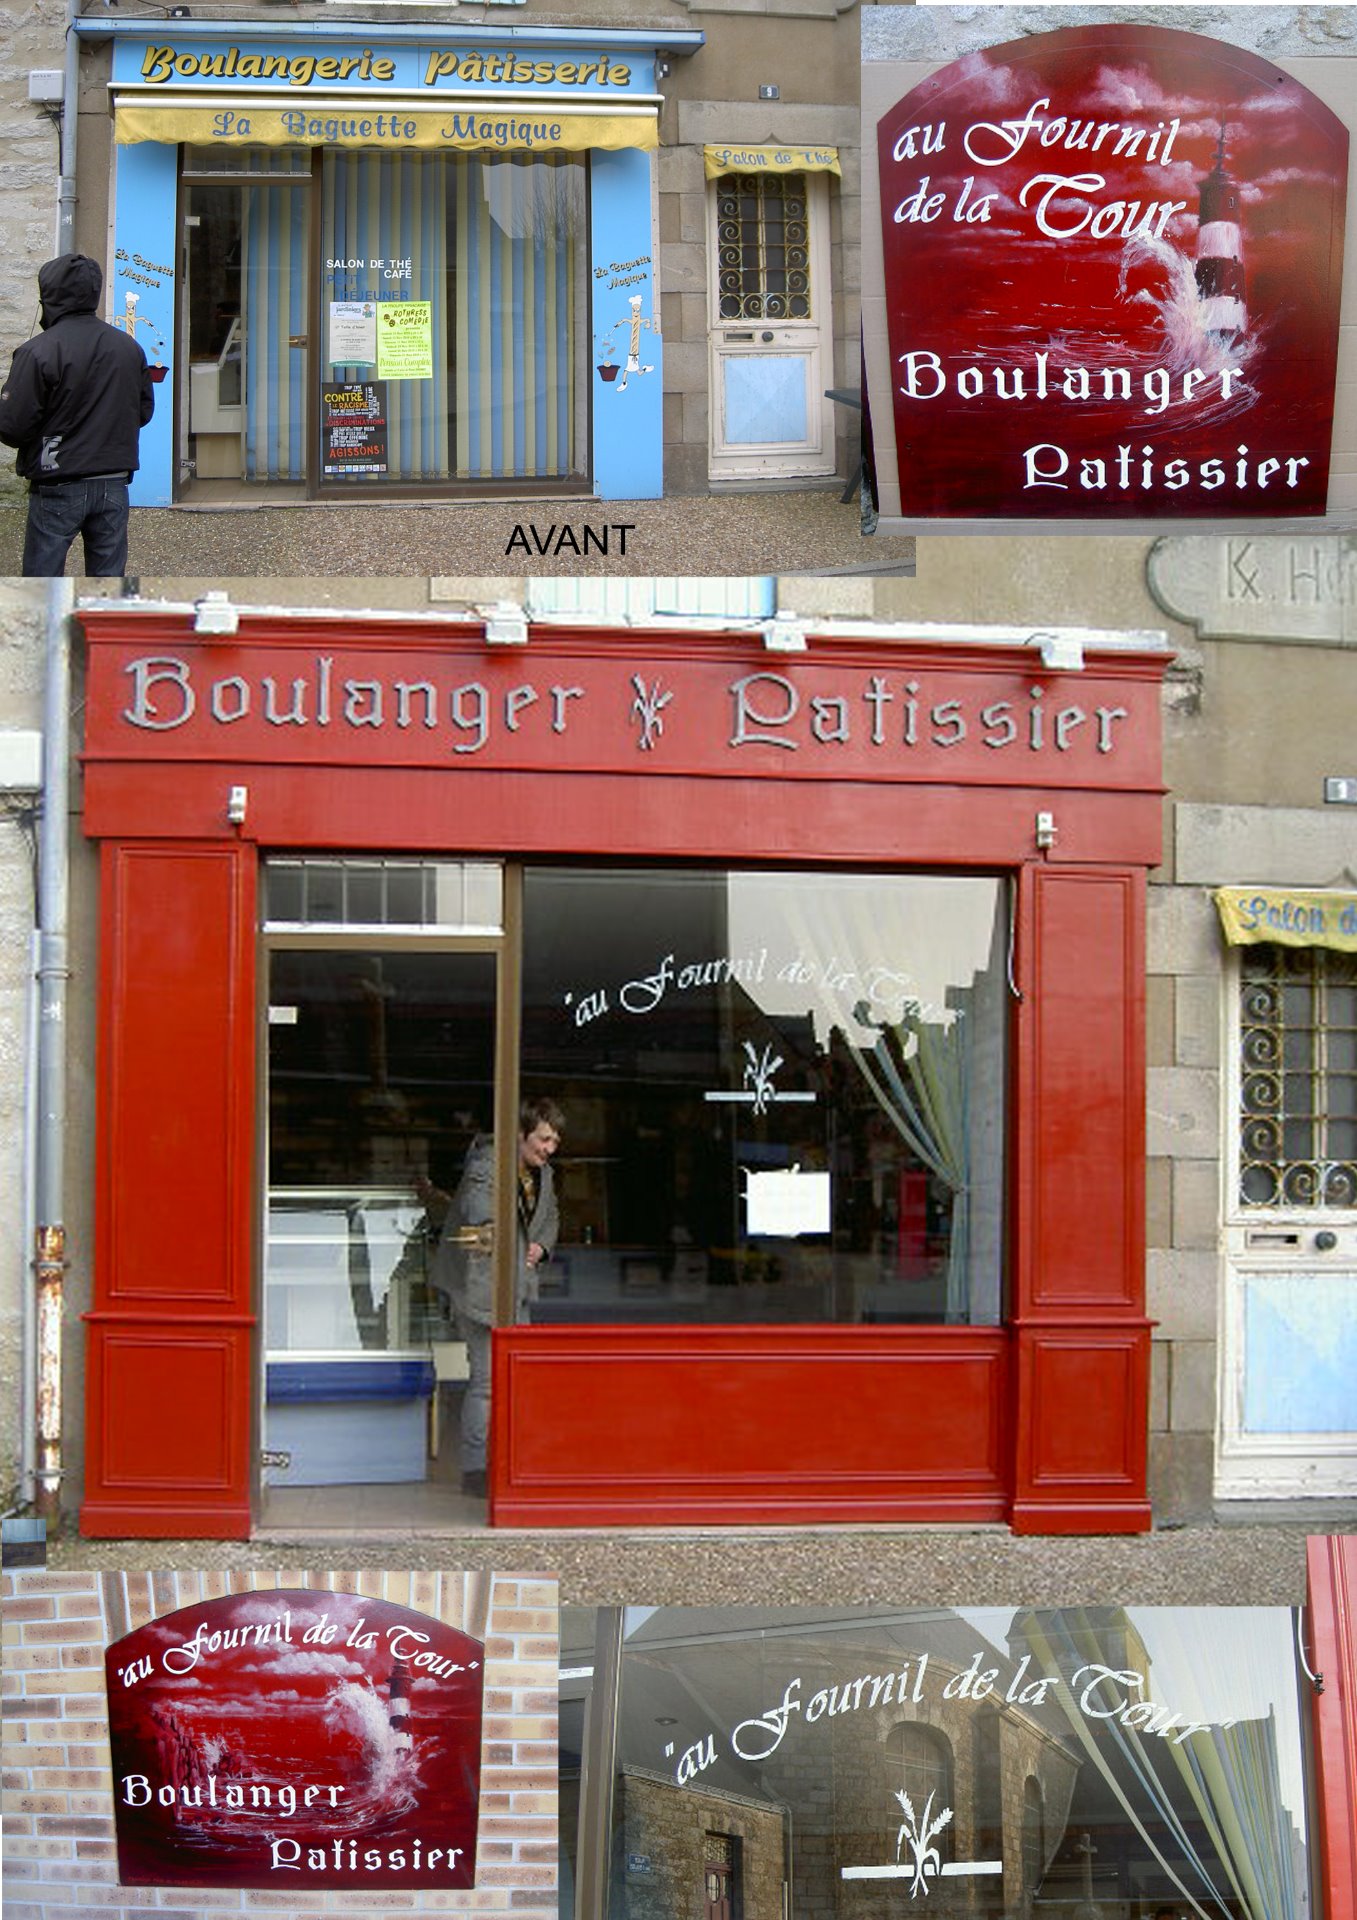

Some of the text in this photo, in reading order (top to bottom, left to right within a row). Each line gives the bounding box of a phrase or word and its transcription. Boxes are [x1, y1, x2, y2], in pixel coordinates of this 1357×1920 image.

[139, 45, 633, 87] Boulangerie Pâtisserie
[212, 112, 562, 146] La Baguette Magique
[892, 121, 946, 162] au
[715, 150, 833, 168] Salon de Thé
[893, 173, 1187, 240] de la Tour
[326, 256, 412, 269] SALON DE THÉ
[383, 268, 412, 279] CAFÉ
[325, 392, 363, 402] CONTRE
[898, 351, 1245, 415] Boulanger
[338, 401, 369, 409] RACISME
[330, 445, 379, 458] AGISSONS
[1022, 443, 1310, 490] Patissier
[121, 656, 1129, 754] Boulanger Patissier
[302, 1614, 338, 1645] de
[346, 1619, 379, 1649] la
[942, 1652, 999, 1699] de
[1004, 1654, 1059, 1707] la
[121, 1774, 346, 1817] Boulanger
[270, 1838, 464, 1872] Patissier
